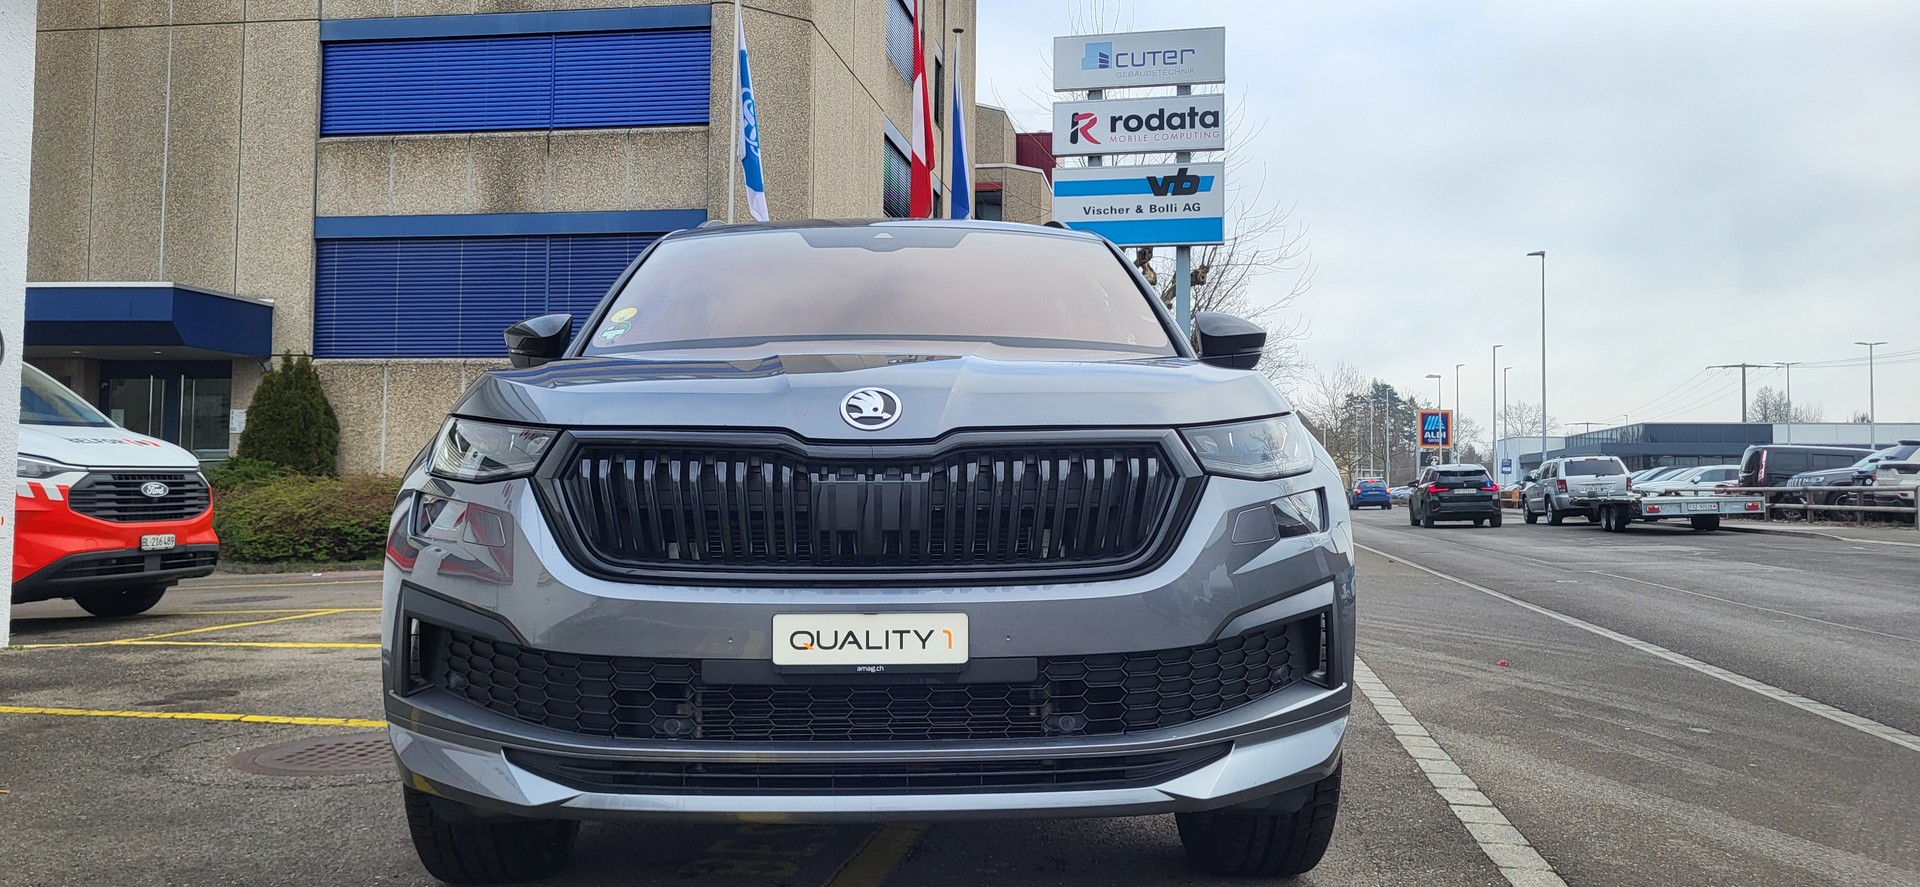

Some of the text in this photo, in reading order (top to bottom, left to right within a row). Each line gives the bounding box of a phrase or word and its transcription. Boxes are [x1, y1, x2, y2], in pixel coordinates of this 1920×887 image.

[1116, 68, 1195, 78] GEBÄUDETECHNIK
[1110, 107, 1219, 132] rodata
[1110, 131, 1220, 143] MOBILE COMPUTING
[1083, 202, 1201, 215] Vischer & Bolli AG
[1424, 431, 1446, 439] ALDI
[146, 484, 165, 495] Ford
[790, 630, 953, 650] QUALITY 1
[857, 665, 885, 673] amag.ch
